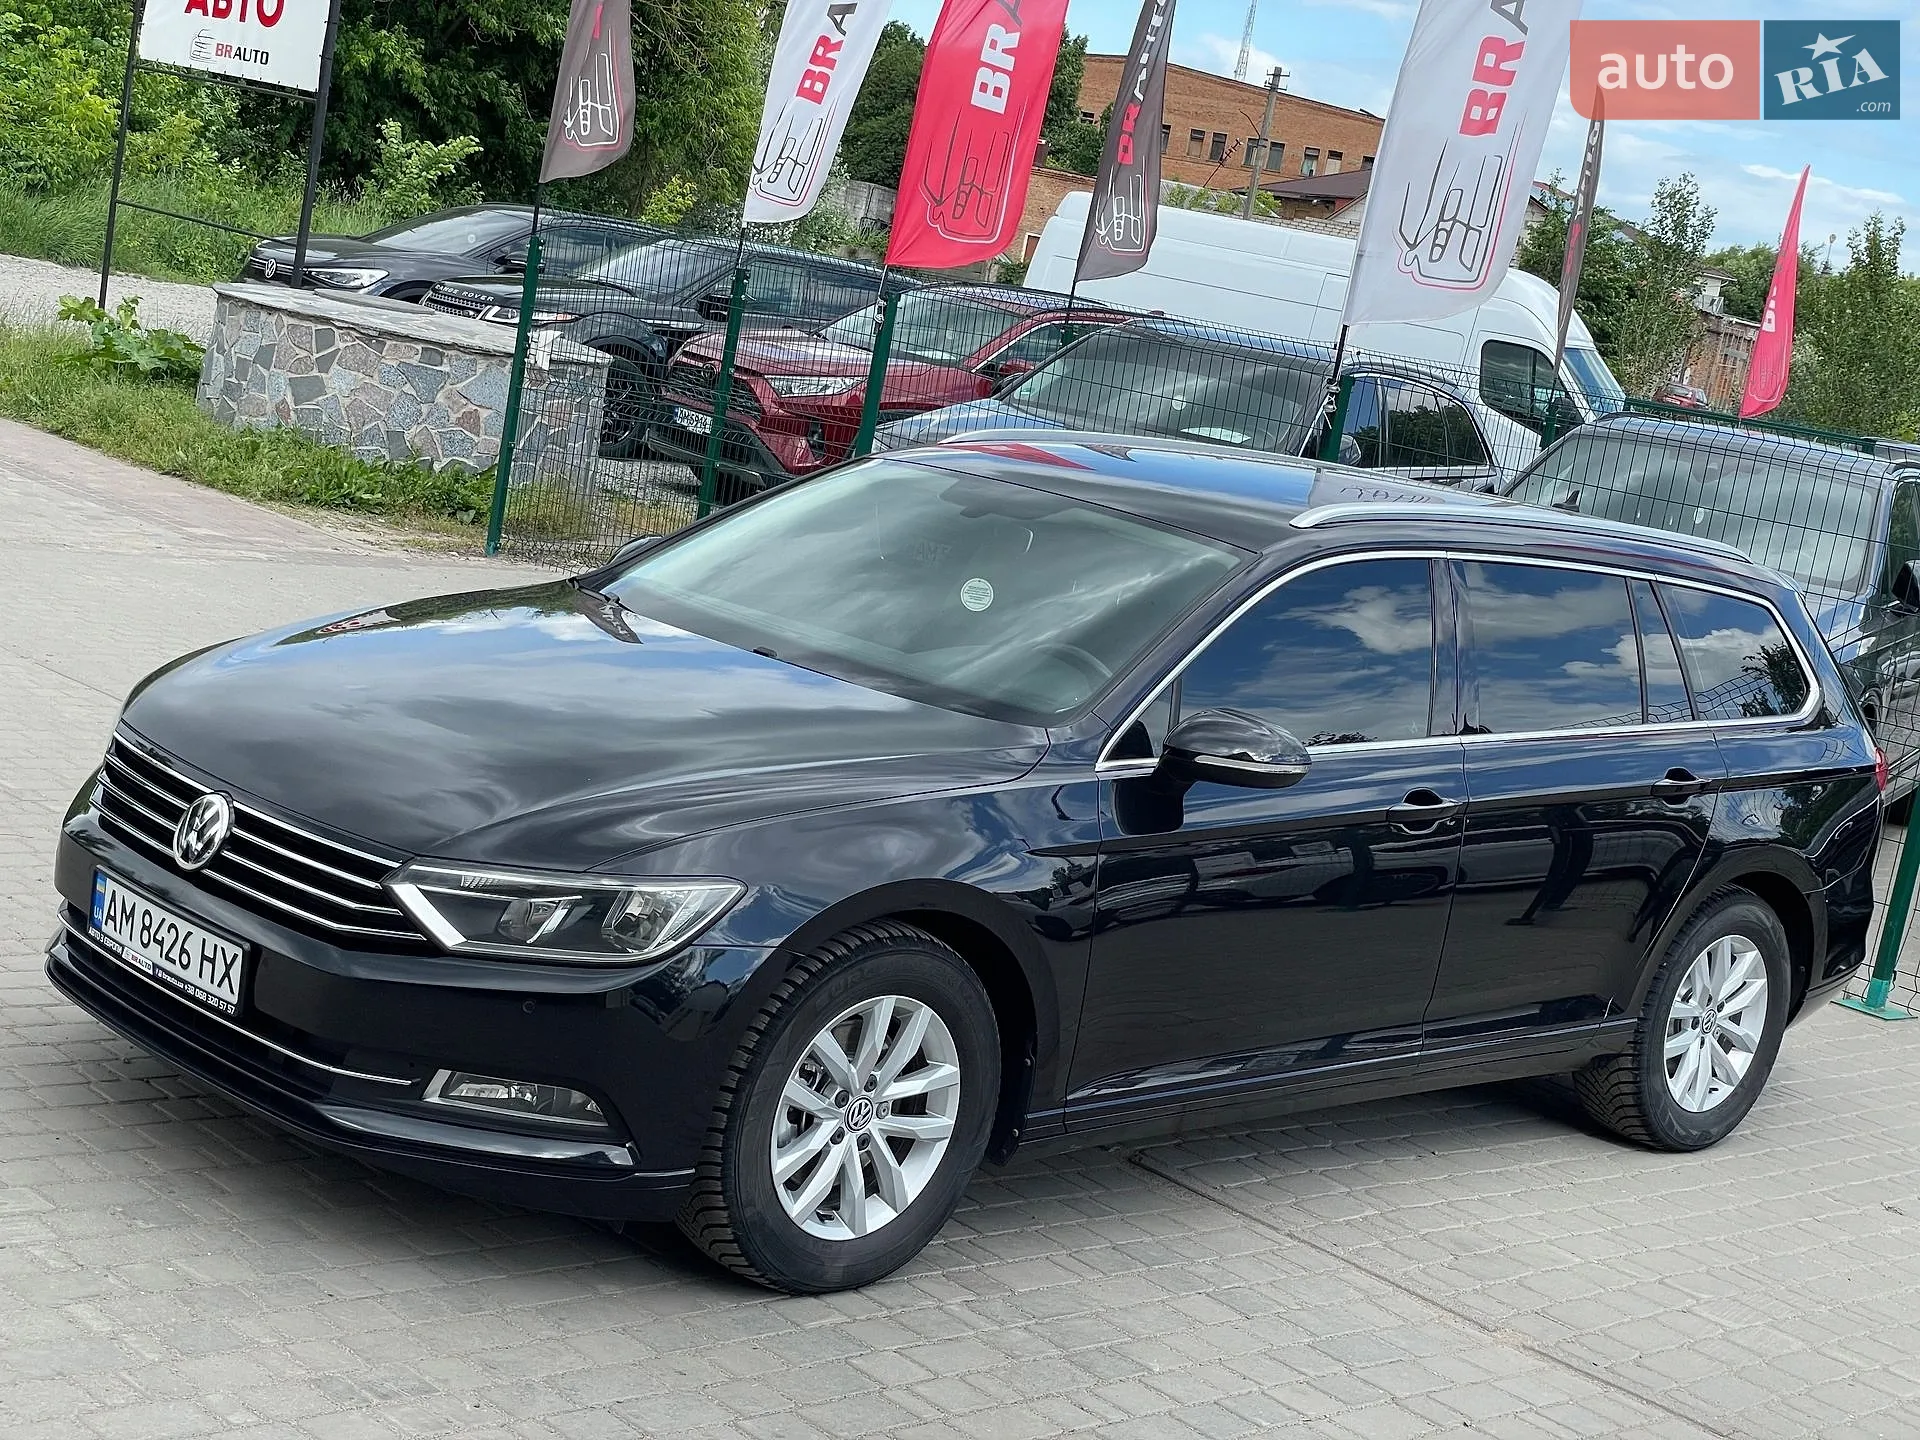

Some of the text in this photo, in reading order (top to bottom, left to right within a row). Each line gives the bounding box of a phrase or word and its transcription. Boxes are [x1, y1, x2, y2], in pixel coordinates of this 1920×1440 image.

[214, 42, 270, 66] BRAUTO
[461, 290, 496, 302] ROVER
[104, 889, 239, 995] AM 8426 HX
[218, 999, 227, 1011] 57
[226, 1003, 235, 1015] 57
